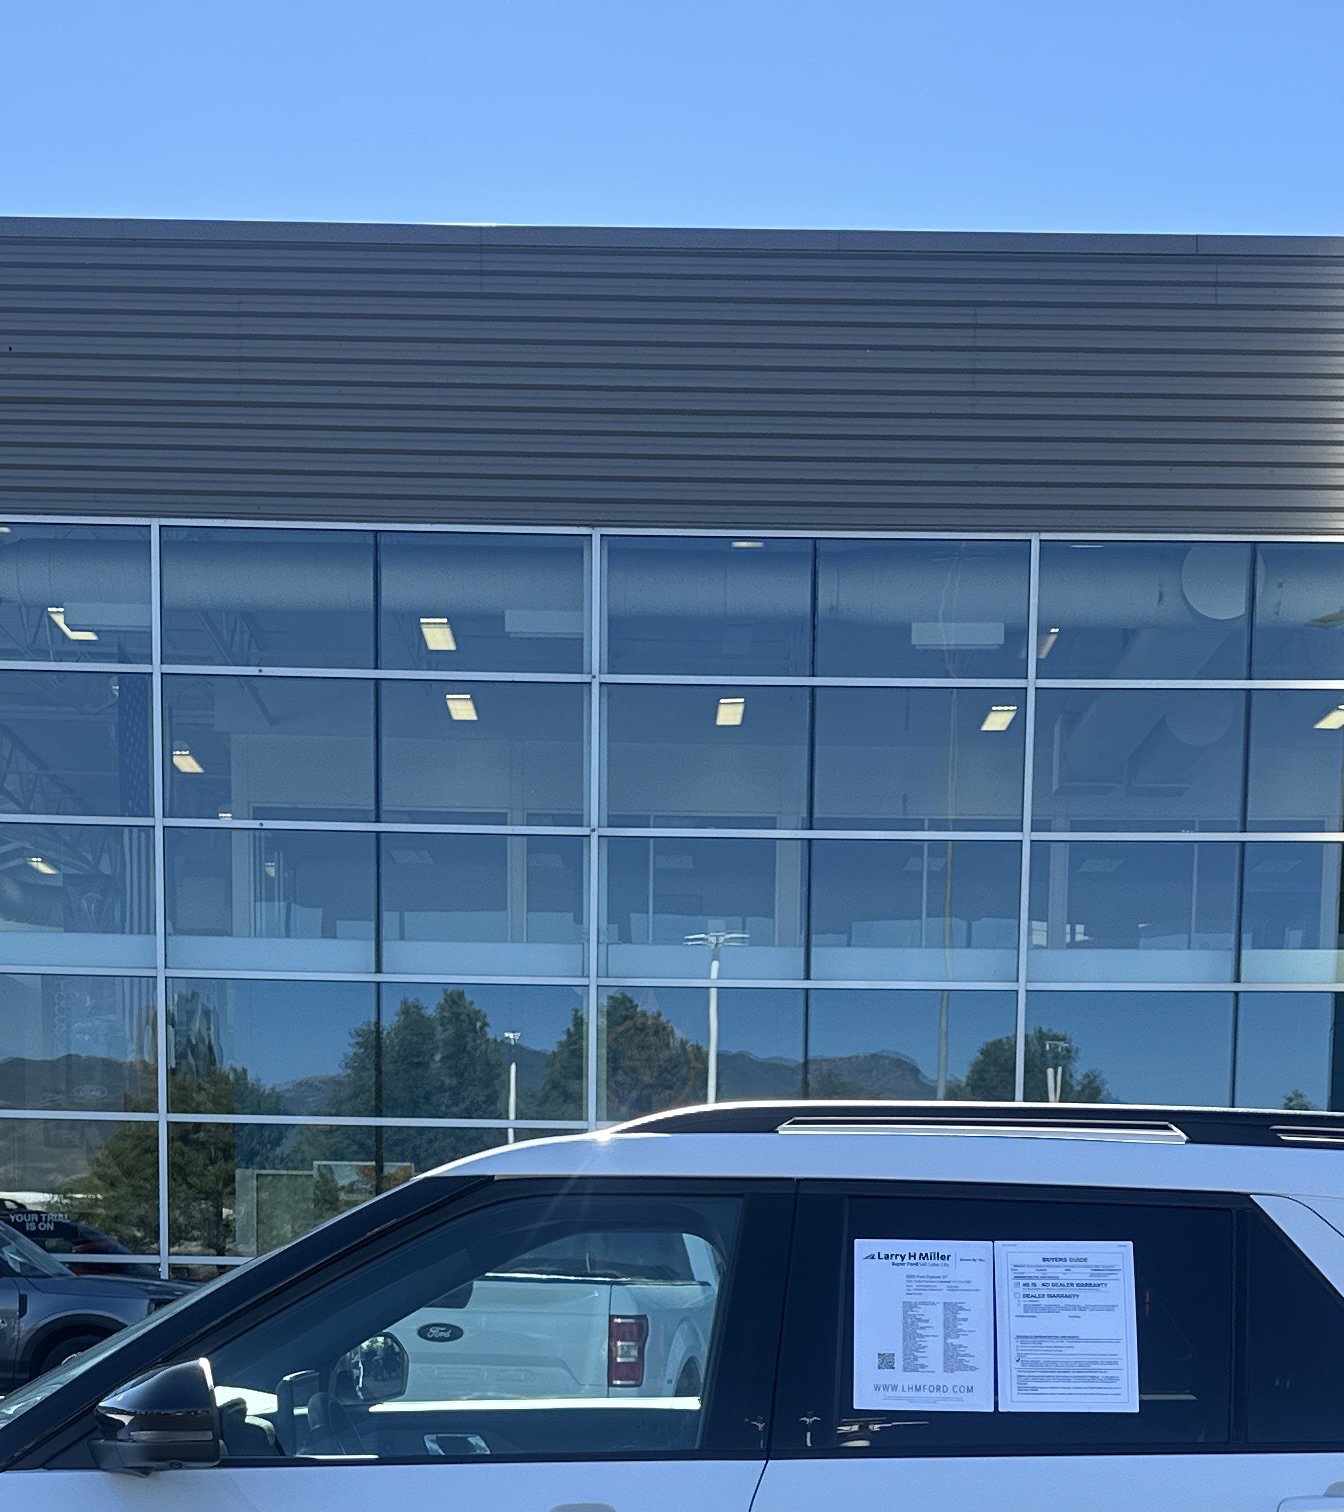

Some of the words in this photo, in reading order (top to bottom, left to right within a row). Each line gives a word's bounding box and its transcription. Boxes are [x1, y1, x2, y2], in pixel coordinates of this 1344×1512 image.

[9, 1213, 38, 1222] YOUR
[25, 1222, 36, 1231] IS
[38, 1222, 54, 1231] ON
[877, 1252, 906, 1262] Larry
[908, 1252, 916, 1260] H
[919, 1252, 951, 1261] Miller
